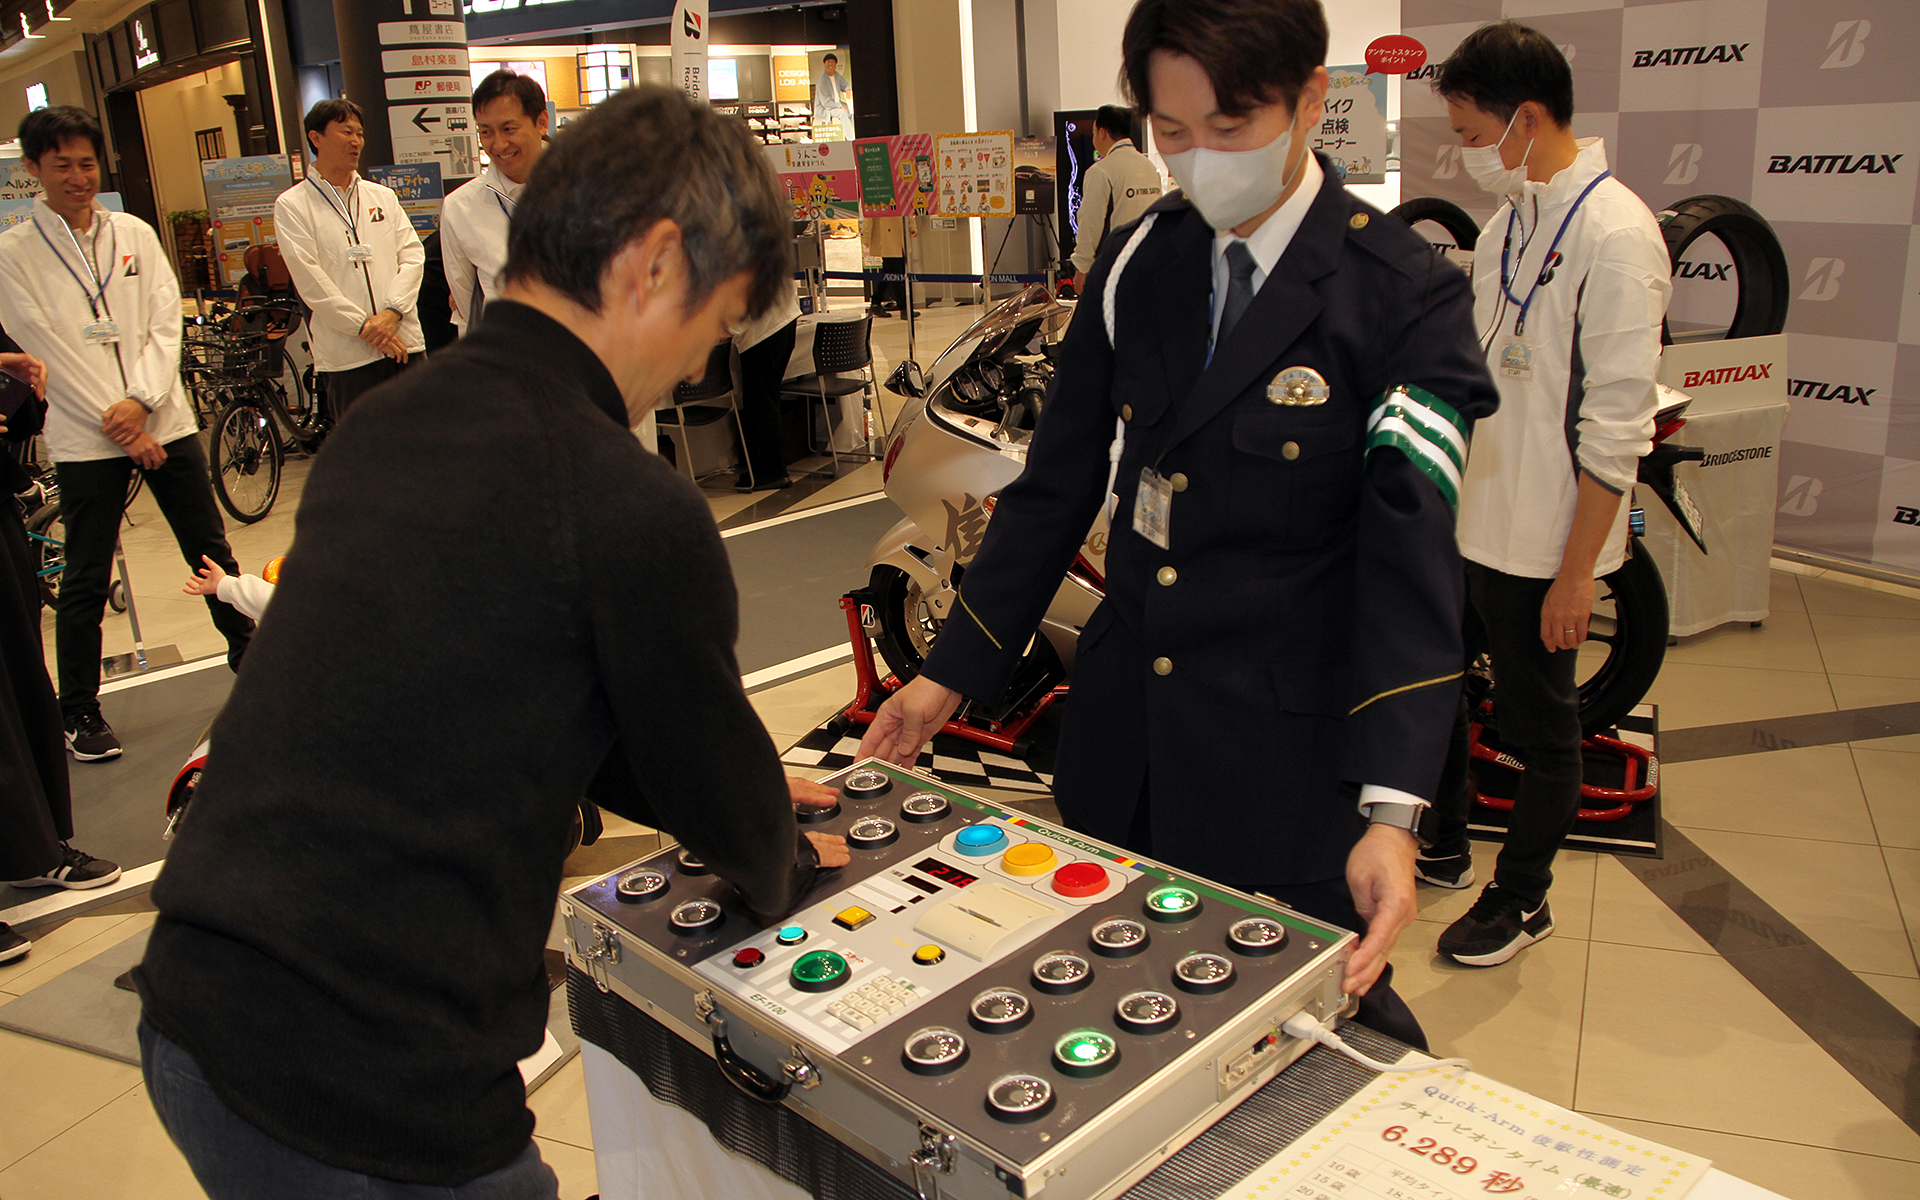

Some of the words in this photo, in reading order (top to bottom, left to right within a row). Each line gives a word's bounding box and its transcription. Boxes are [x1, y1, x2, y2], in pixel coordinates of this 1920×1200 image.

[411, 54, 457, 66] 島村楽器
[1367, 48, 1425, 57] アンケートスタンプ
[1380, 56, 1406, 64] ポイント
[1632, 42, 1751, 69] BATTLAX
[436, 81, 461, 92] 郵便局
[1321, 118, 1350, 135] 点検
[1313, 137, 1357, 150] コーナー
[1766, 153, 1905, 175] BATTLAX
[5, 179, 43, 190] ヘルメッ
[1683, 362, 1774, 389] BATTLAX
[1698, 446, 1774, 468] BRIDGESTONE
[1037, 828, 1073, 846] Quick
[1072, 841, 1100, 855] Arm
[749, 993, 788, 1016] EF-1100
[1424, 1085, 1526, 1136] Quick-Arm
[1532, 1133, 1647, 1178] 俊敏性測定
[1328, 1160, 1346, 1173] 10
[1381, 1124, 1479, 1176] 6.289
[1480, 1169, 1525, 1194] 秒
[1312, 1172, 1331, 1185] 15
[1391, 1168, 1446, 1200] 平均タイ
